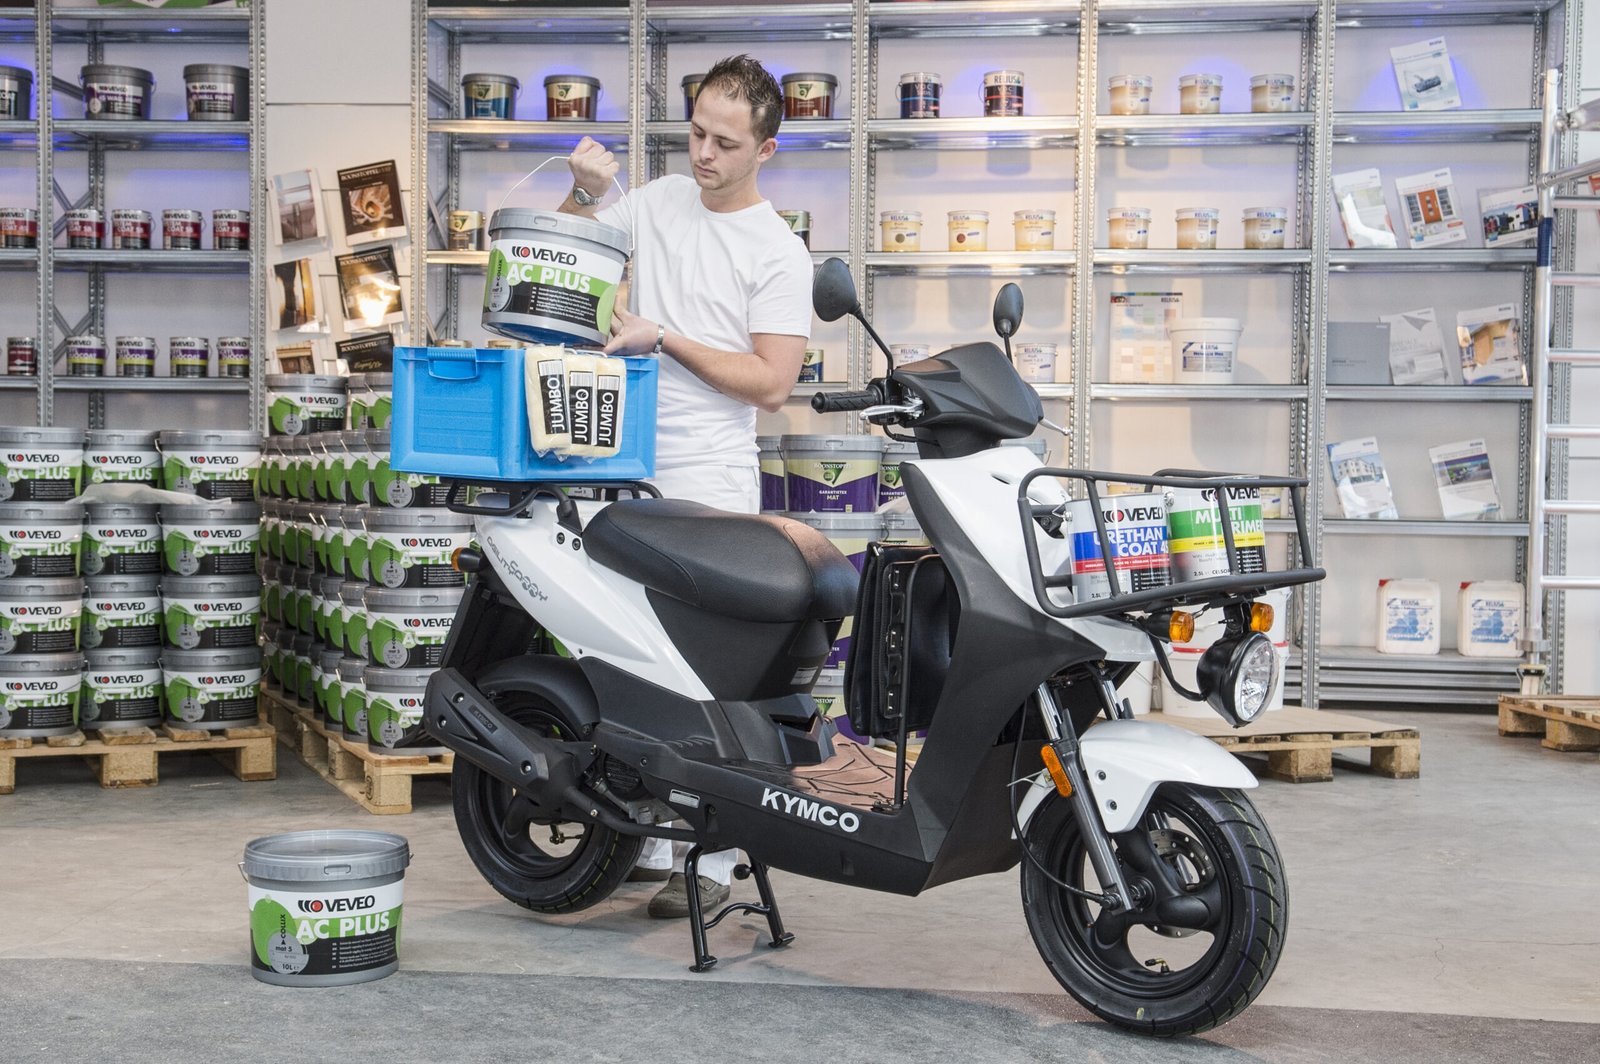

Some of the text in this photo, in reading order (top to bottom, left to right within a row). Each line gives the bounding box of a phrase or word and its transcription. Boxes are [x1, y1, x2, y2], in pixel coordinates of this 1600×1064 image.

[994, 75, 1017, 84] REIUS
[531, 247, 577, 266] VEVEO
[506, 263, 591, 293] AC PLUS
[316, 396, 339, 405] VEVEO
[547, 377, 565, 430] JUMBO
[574, 389, 589, 442] JUMBO
[599, 392, 614, 444] JUMBO
[25, 454, 60, 463] VEVEO
[109, 455, 142, 464] VEVEO
[206, 456, 239, 465] VEVEO
[1124, 507, 1164, 522] VEVEO
[1195, 507, 1242, 524] MUTI
[1222, 520, 1263, 534] RIMER
[27, 530, 61, 539] VEVEO
[115, 529, 147, 538] VEVEO
[210, 529, 242, 538] VEVEO
[419, 538, 452, 547] VEVEO
[1119, 541, 1158, 557] COAT
[28, 606, 62, 615] VEVEO
[113, 602, 145, 611] VEVEO
[210, 602, 242, 612] VEVEO
[421, 618, 453, 627] VEVEO
[110, 675, 144, 684] VEVEO
[214, 675, 246, 684] VEVEO
[23, 681, 58, 691] VEVEO
[761, 788, 860, 833] KYMCO
[325, 895, 376, 912] VEVEO
[296, 911, 390, 939] AC PLUS
[282, 963, 293, 971] 10L
